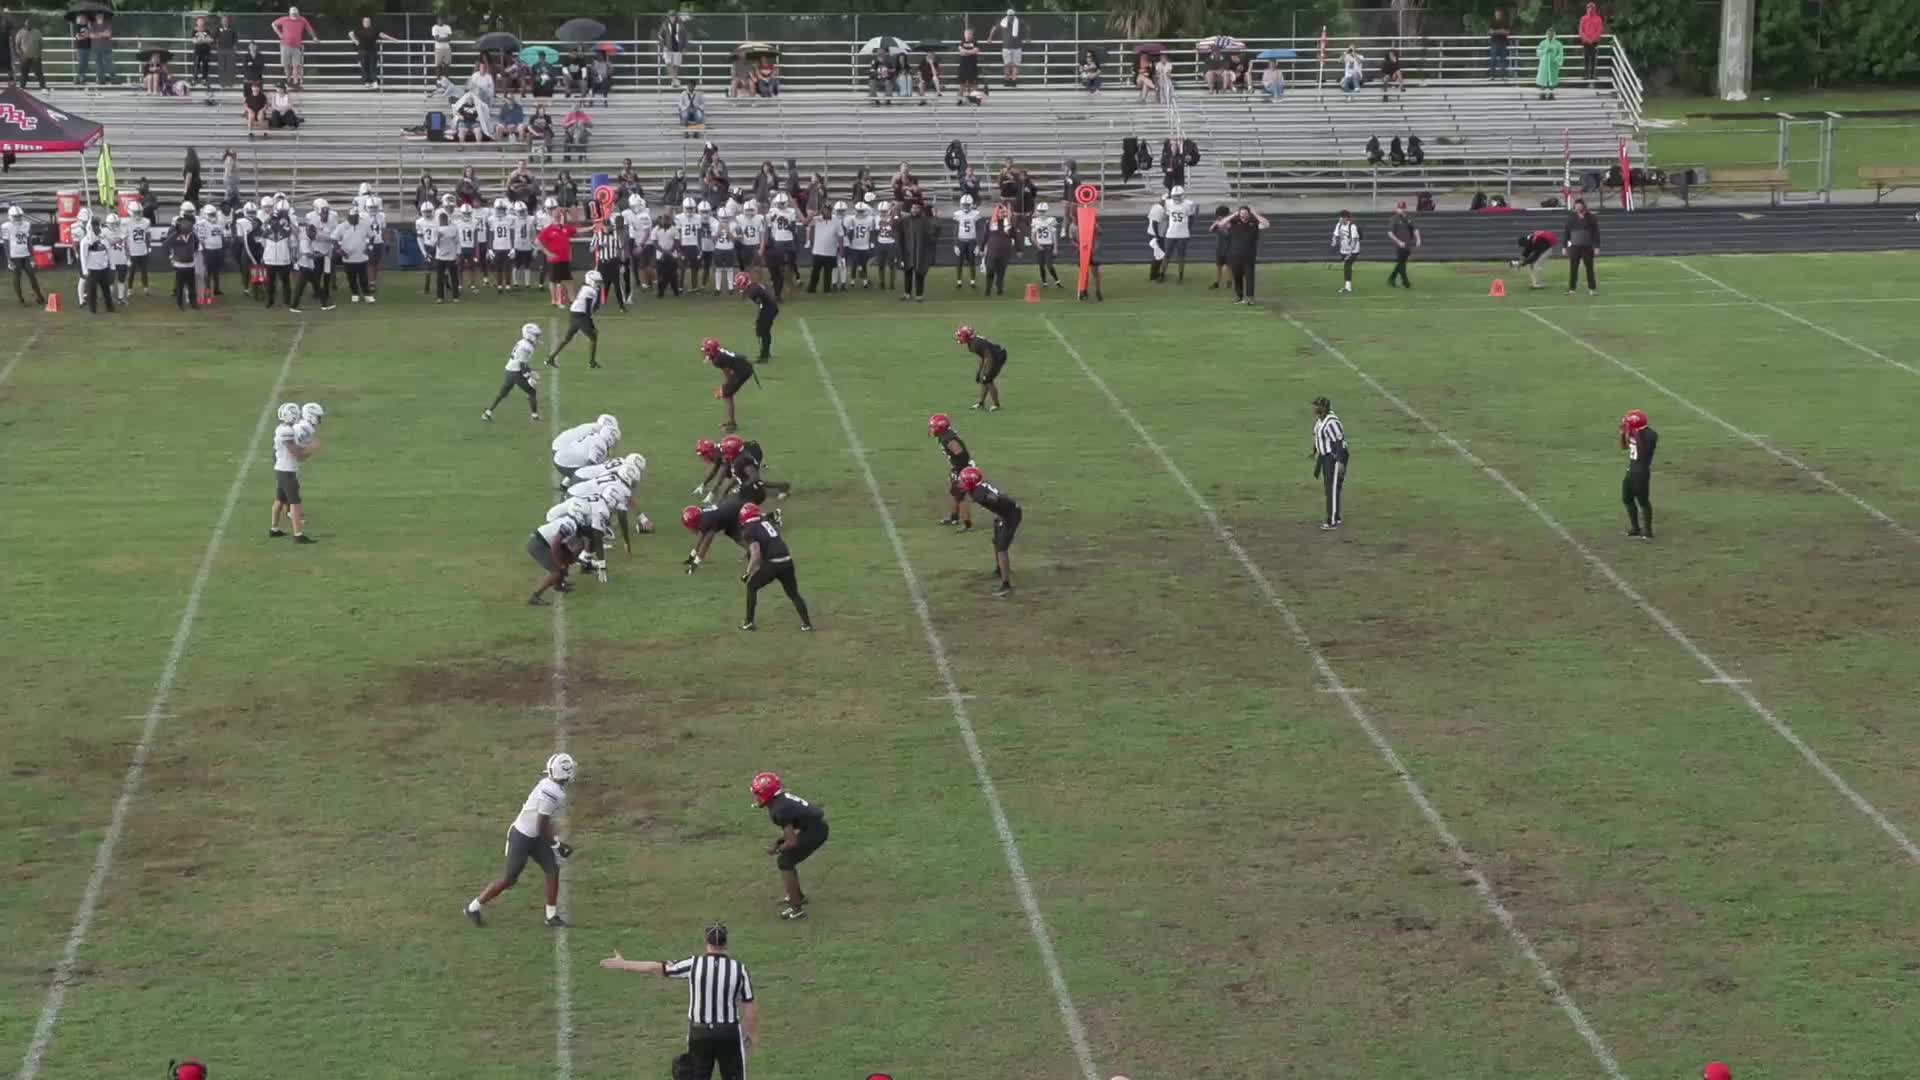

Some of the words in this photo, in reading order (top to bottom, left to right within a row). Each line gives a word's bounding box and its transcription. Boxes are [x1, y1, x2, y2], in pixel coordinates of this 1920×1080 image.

[1171, 211, 1183, 222] 55
[684, 224, 696, 236] 24
[855, 226, 866, 238] 15
[963, 221, 971, 233] 5
